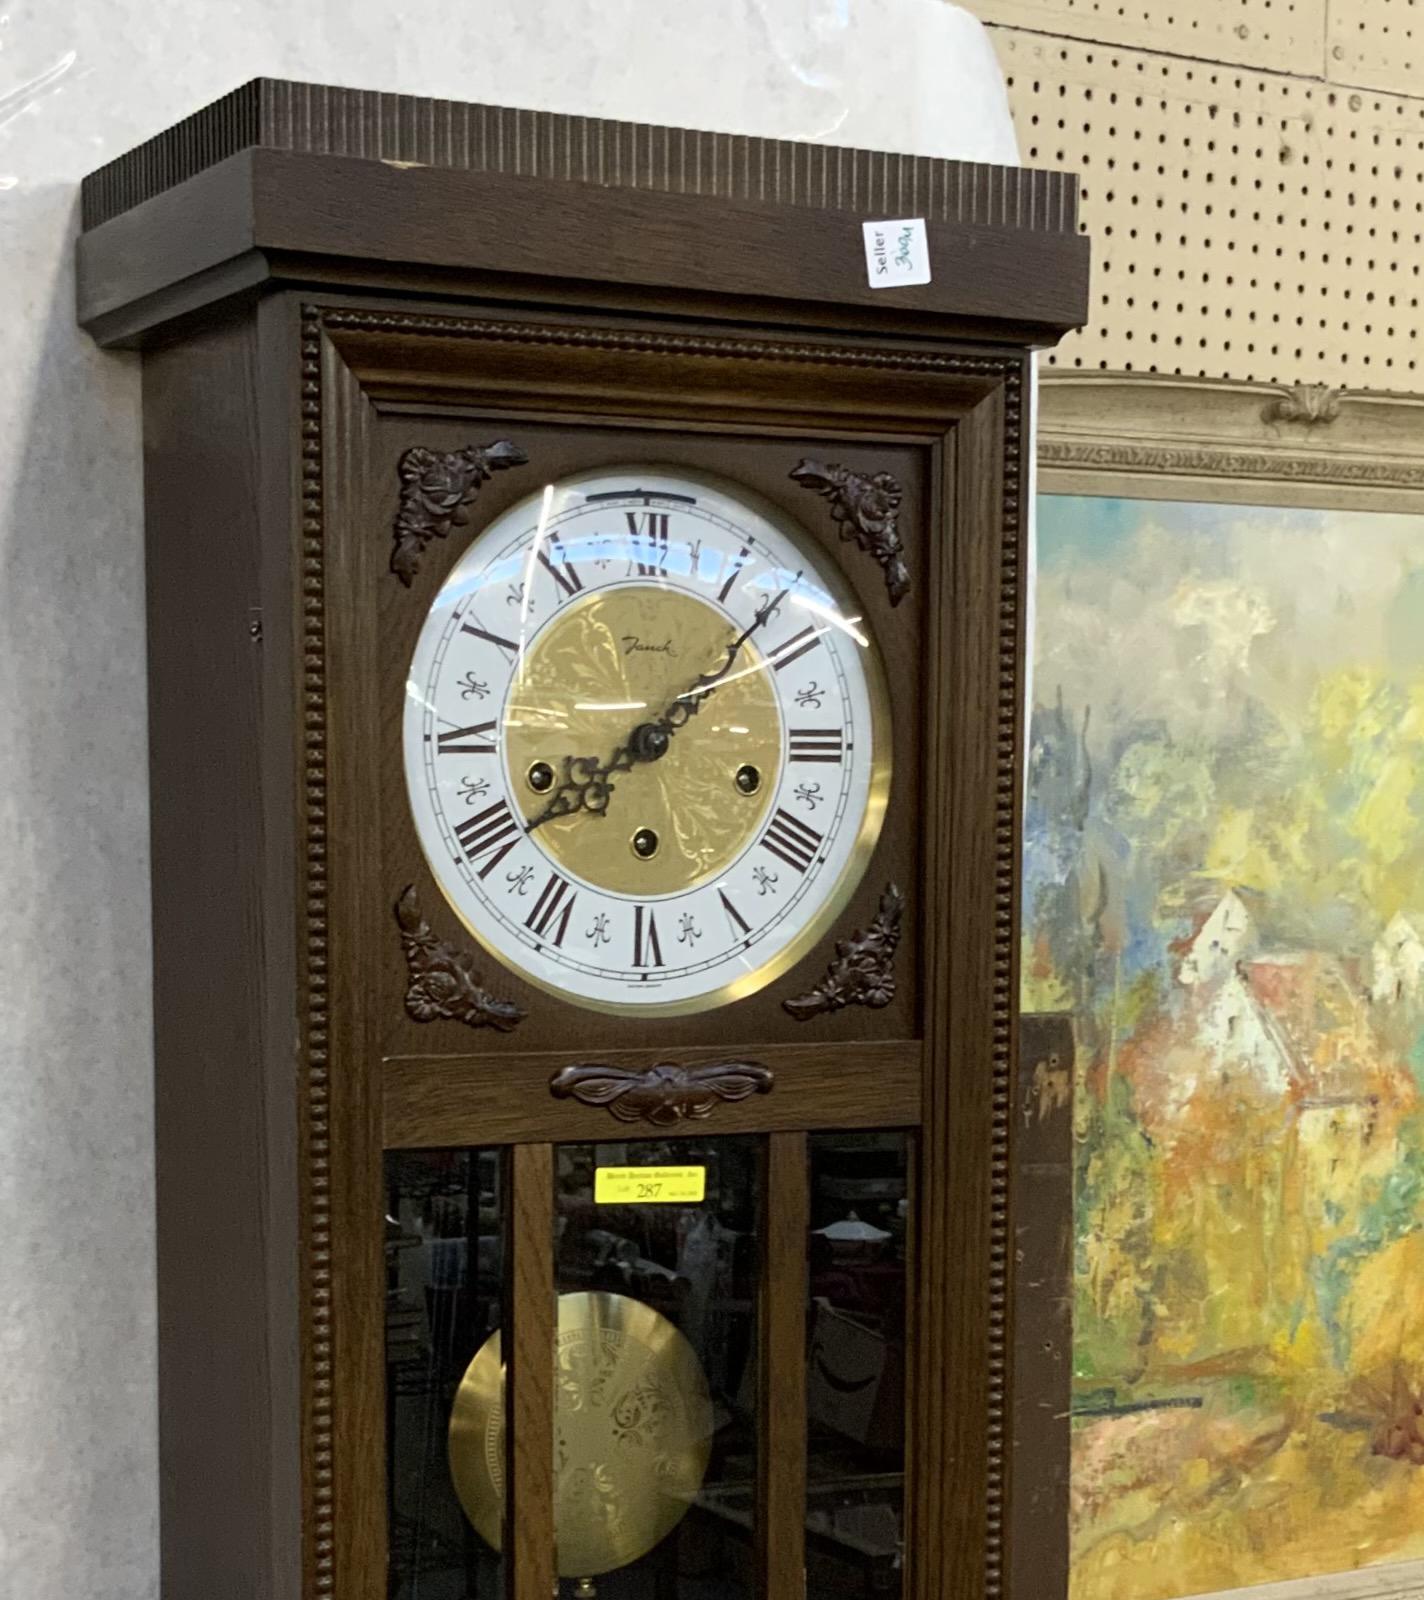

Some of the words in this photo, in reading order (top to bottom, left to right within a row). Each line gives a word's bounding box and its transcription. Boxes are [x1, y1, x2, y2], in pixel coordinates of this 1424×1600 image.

[873, 230, 888, 275] Seller
[460, 610, 520, 665] X
[789, 728, 843, 763] III
[453, 799, 523, 880] VIII
[759, 808, 823, 874] IIII
[523, 873, 578, 948] VII
[631, 905, 666, 967] VI
[717, 887, 754, 943] V
[636, 1183, 663, 1198] 287
